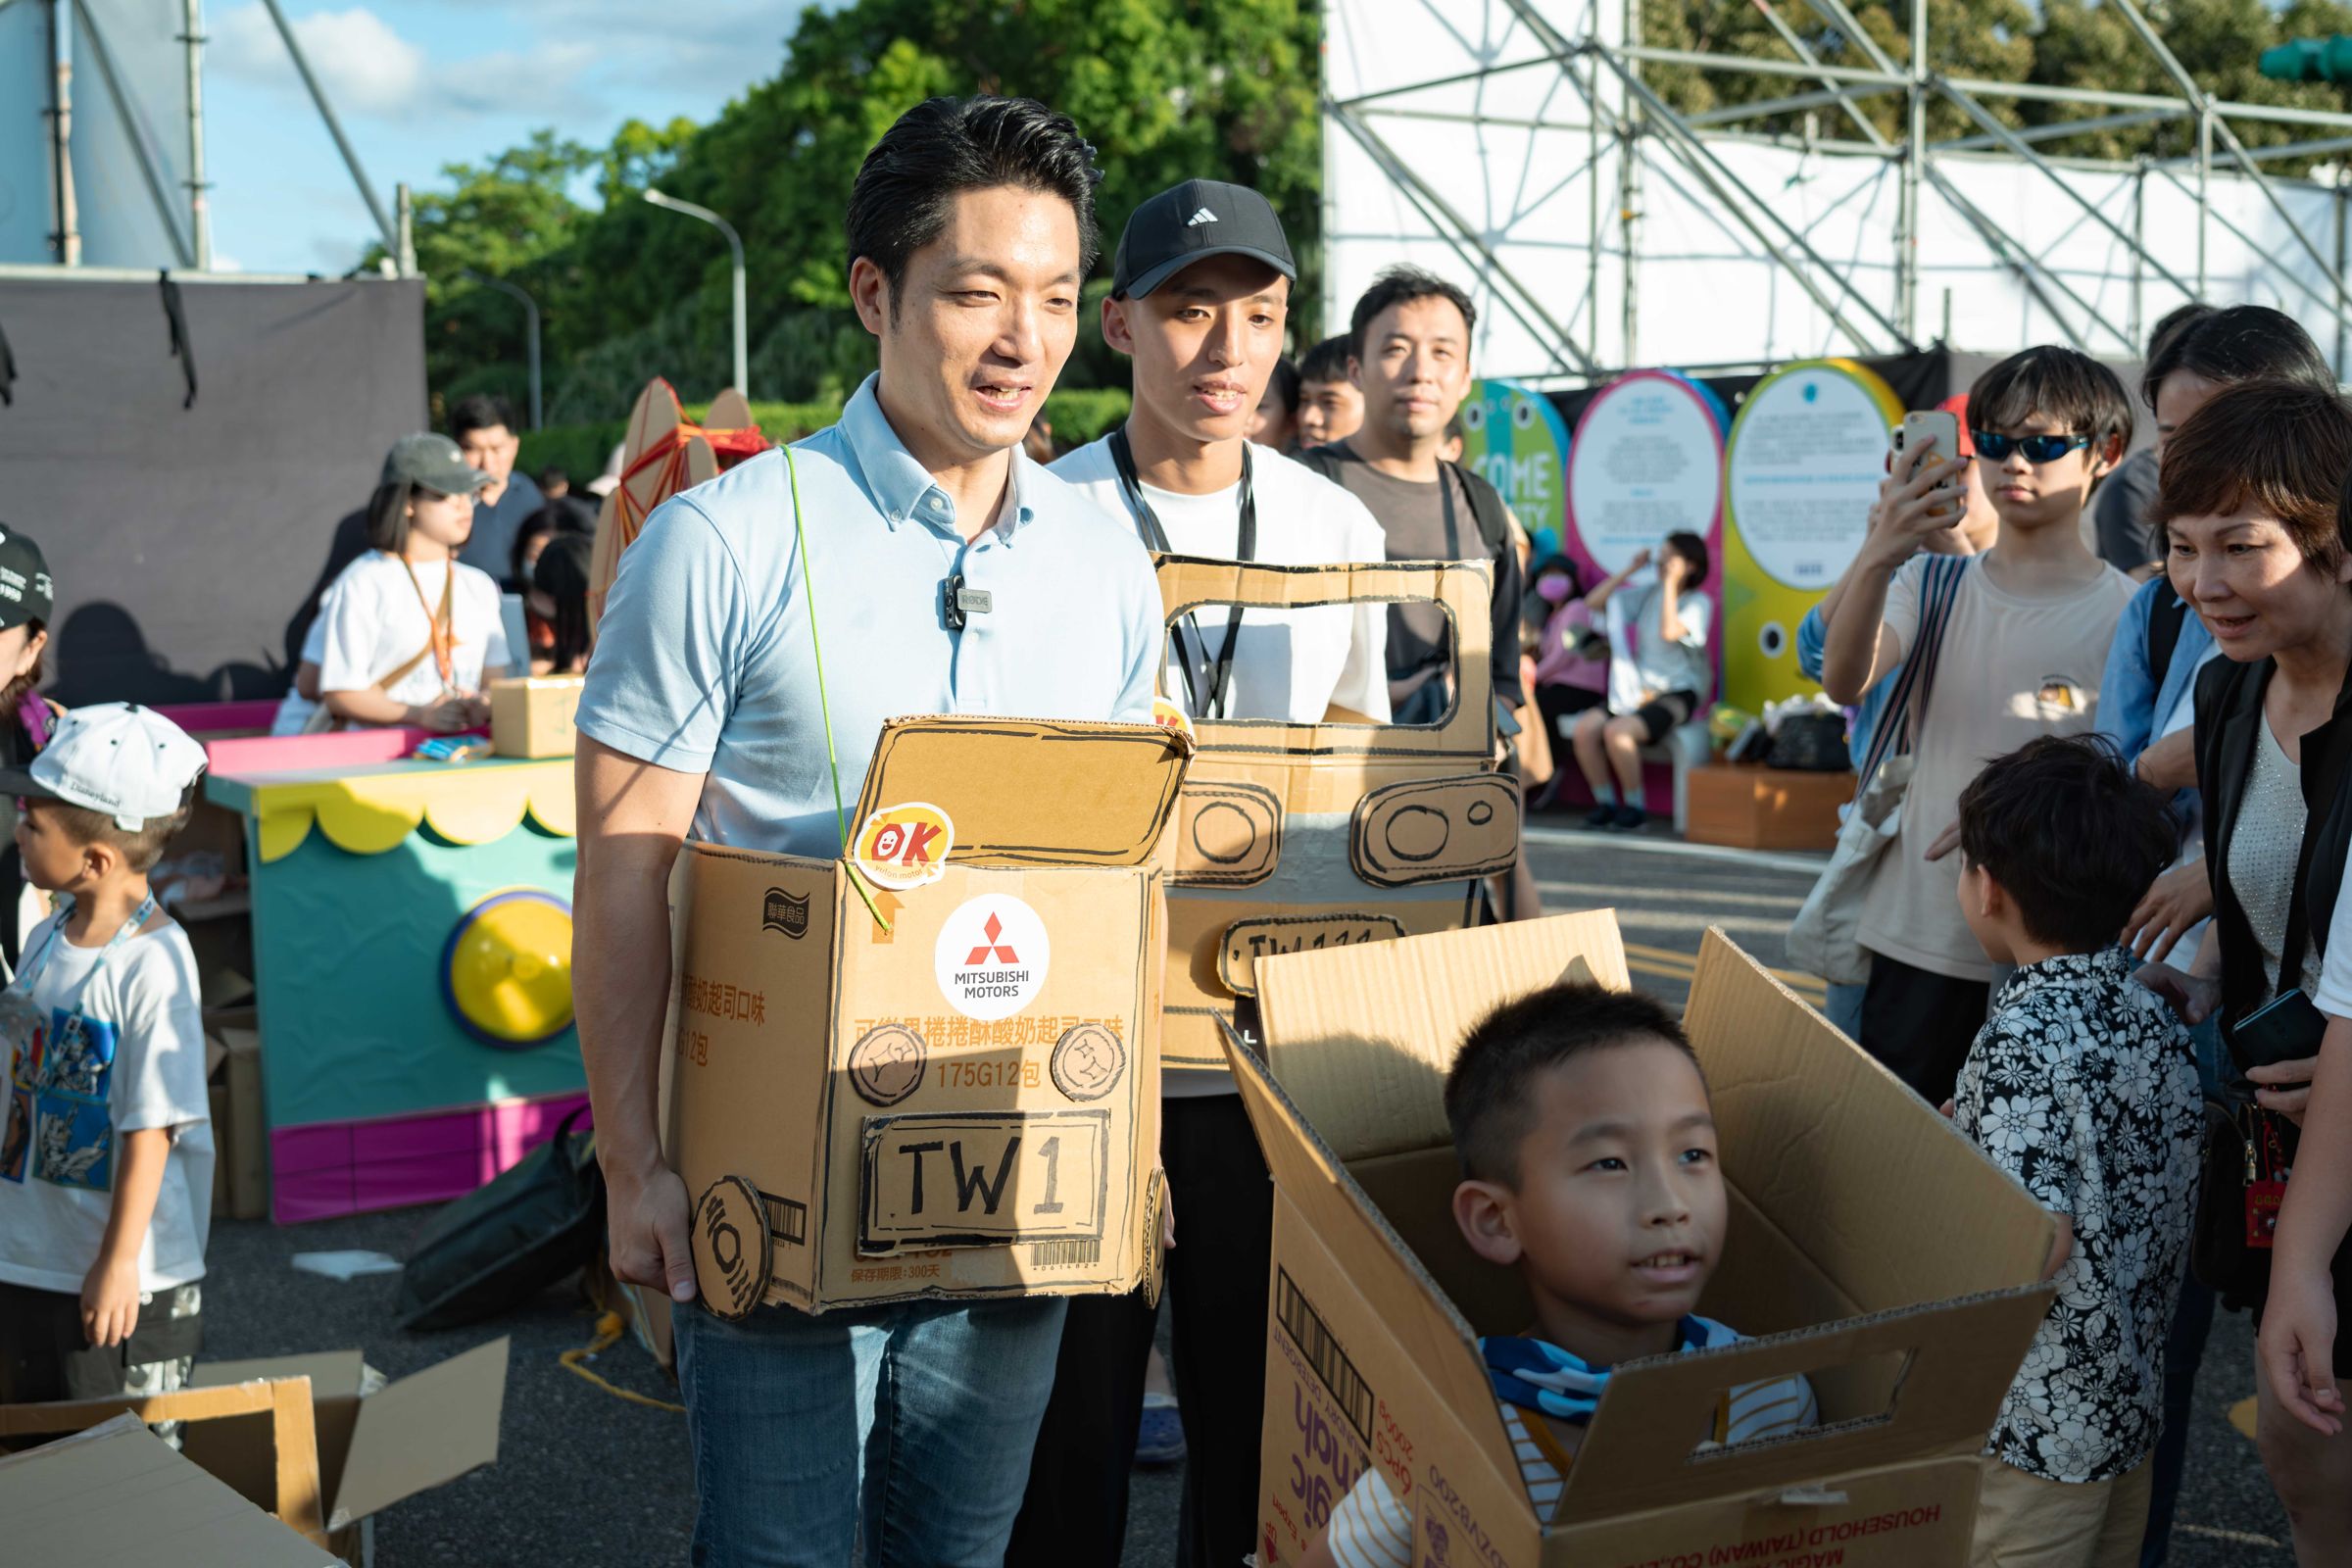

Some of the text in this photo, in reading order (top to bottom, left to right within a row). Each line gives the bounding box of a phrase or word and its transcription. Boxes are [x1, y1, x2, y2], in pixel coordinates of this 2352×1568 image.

[871, 821, 942, 868] OK
[767, 902, 805, 925] 聯華食品
[955, 970, 1029, 985] MITSUBISHI
[964, 985, 1019, 999] MOTORS
[937, 1059, 1041, 1089] 175G12包
[1273, 1326, 1322, 1404] DETERGENT
[1294, 1380, 1361, 1495] mah
[1324, 1399, 1367, 1461] AUNDRY
[1379, 1398, 1413, 1462] 2000g
[1376, 1431, 1412, 1495] 6PCS
[1291, 1453, 1333, 1530] gic
[1708, 1527, 1805, 1564] (TAIWAN)
[1809, 1504, 1941, 1545] HOUSEHOLD
